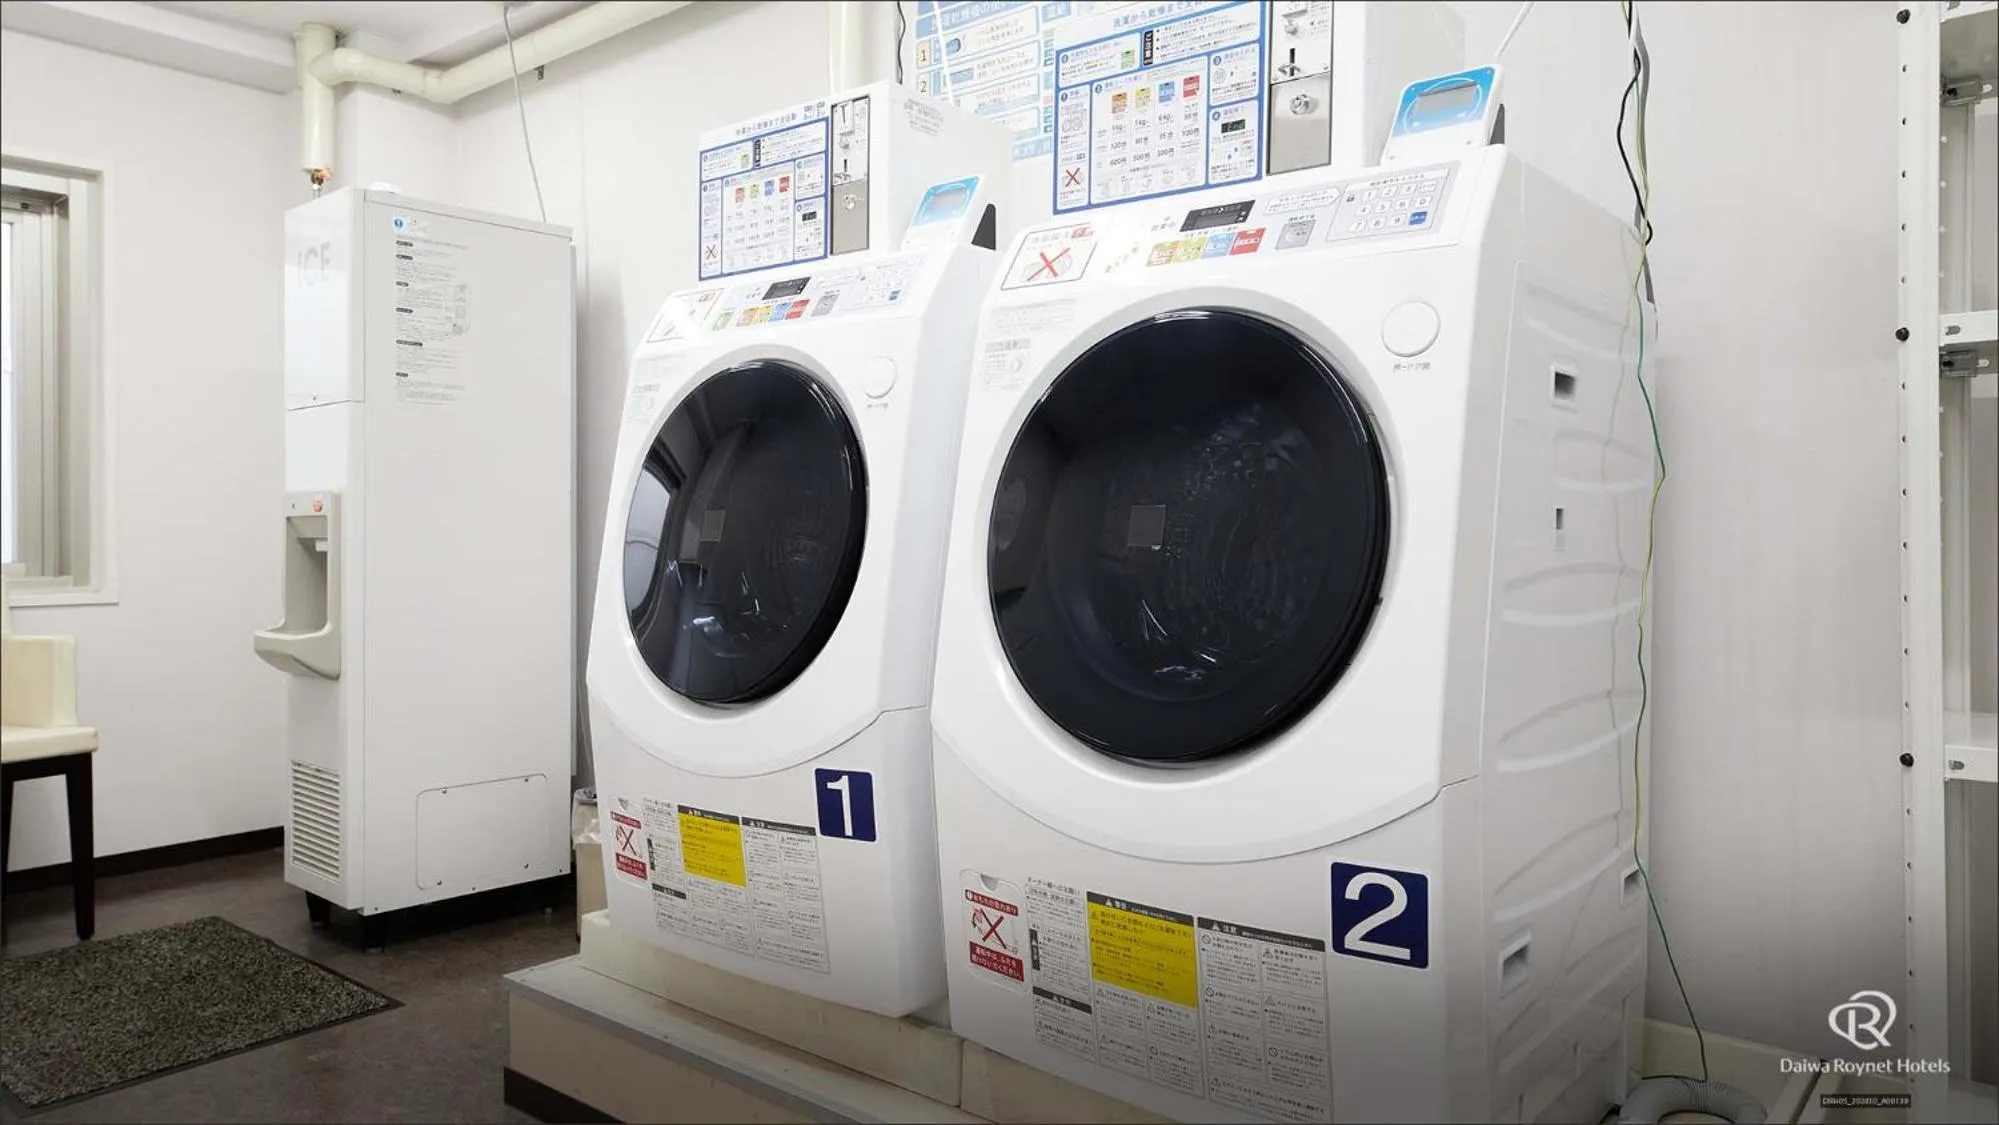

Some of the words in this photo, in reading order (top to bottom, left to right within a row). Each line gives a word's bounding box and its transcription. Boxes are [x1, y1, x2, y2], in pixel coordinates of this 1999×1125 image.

[297, 241, 331, 289] ICE
[826, 775, 853, 838] 1
[1344, 871, 1412, 961] 2
